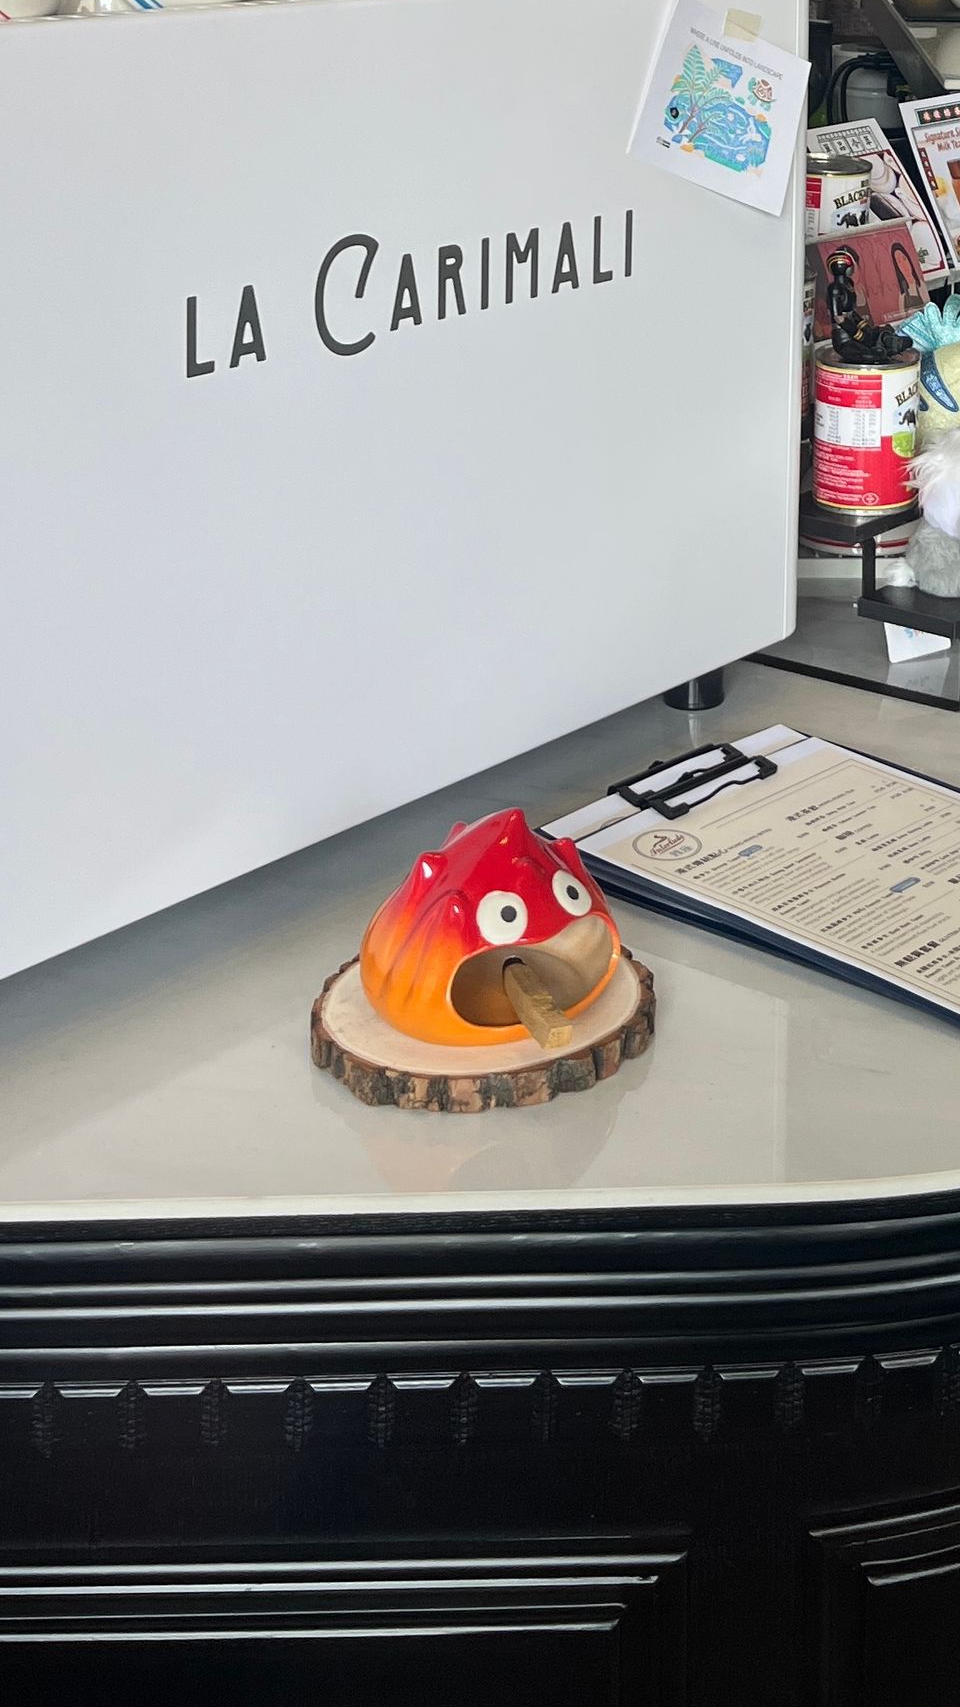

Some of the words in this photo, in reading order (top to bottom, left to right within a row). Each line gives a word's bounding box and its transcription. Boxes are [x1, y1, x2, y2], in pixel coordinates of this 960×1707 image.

[925, 130, 954, 144] Signature
[937, 142, 951, 151] Milk
[186, 284, 267, 378] LA
